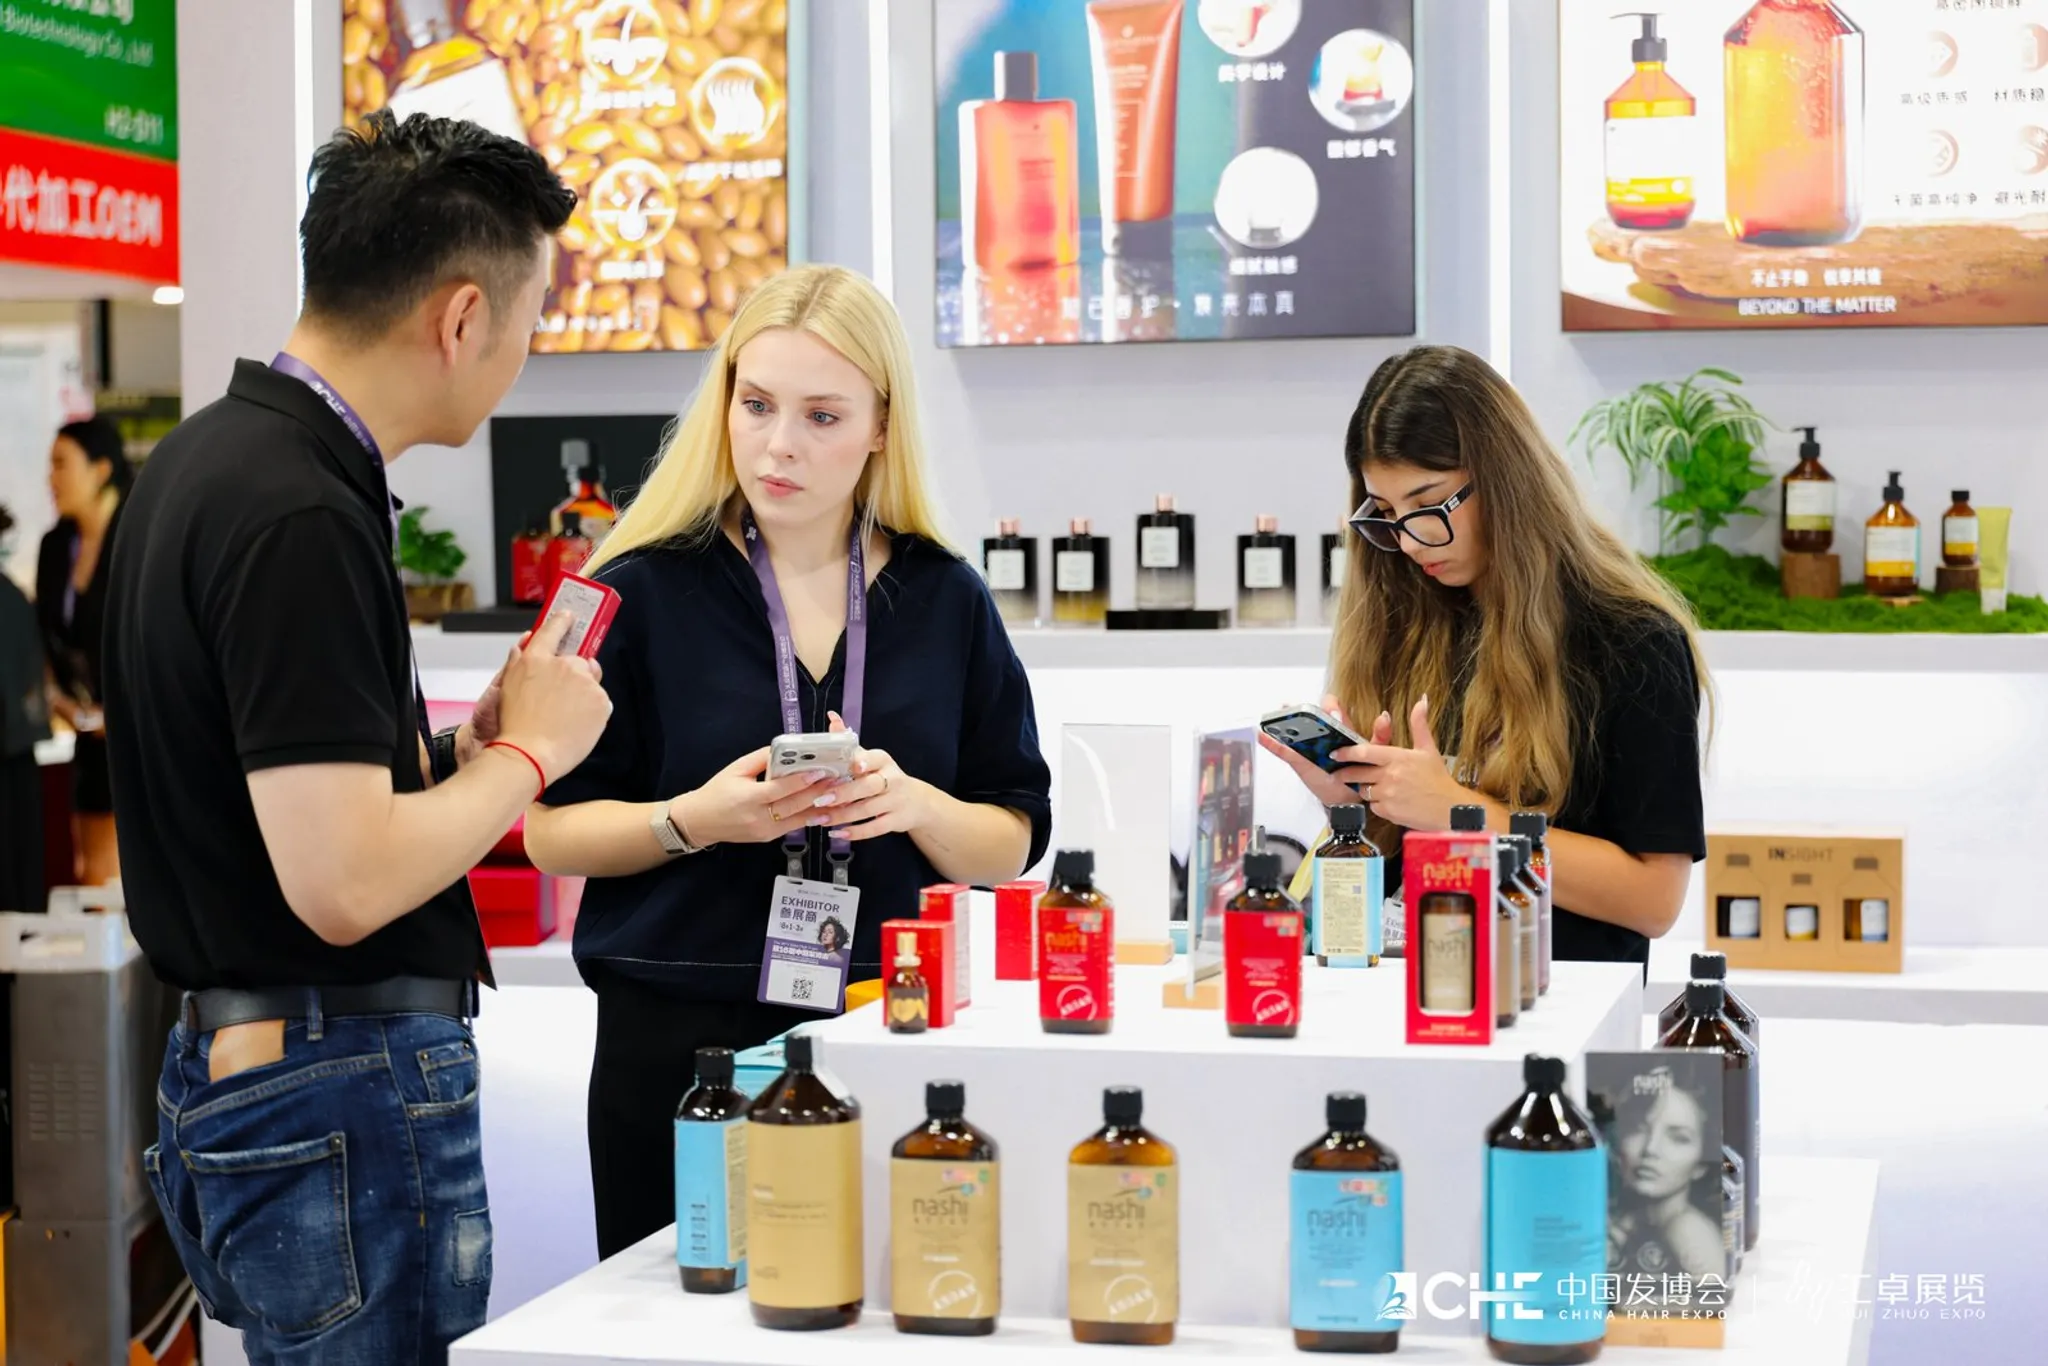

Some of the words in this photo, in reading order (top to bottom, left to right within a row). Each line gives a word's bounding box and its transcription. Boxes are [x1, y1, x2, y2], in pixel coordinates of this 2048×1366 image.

[1738, 298, 1800, 316] BEYOND
[1801, 297, 1832, 314] THE
[1835, 295, 1897, 313] MATTER
[1768, 848, 1834, 862] INSIGHT
[781, 896, 840, 913] EXHIBITOR
[912, 1194, 968, 1216] nashi
[1087, 1198, 1145, 1220] nashi
[1307, 1206, 1366, 1229] nashi
